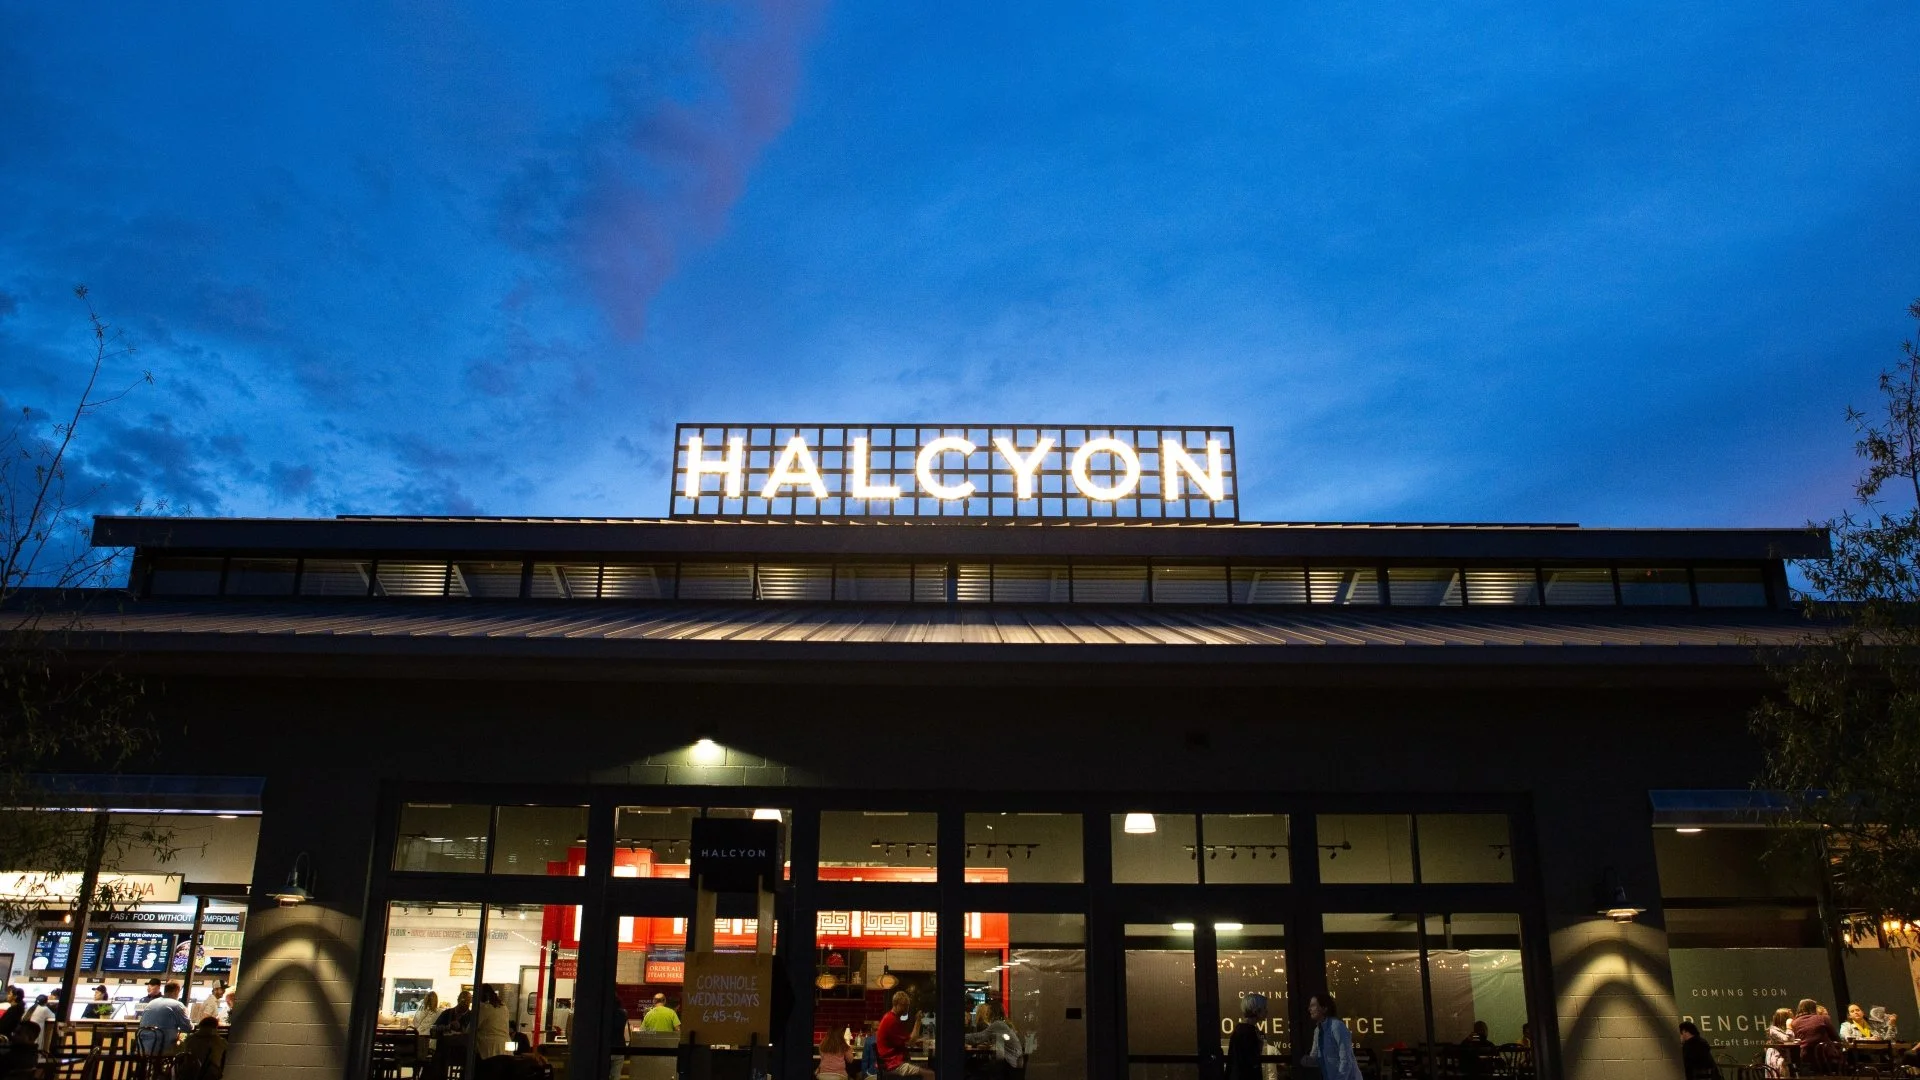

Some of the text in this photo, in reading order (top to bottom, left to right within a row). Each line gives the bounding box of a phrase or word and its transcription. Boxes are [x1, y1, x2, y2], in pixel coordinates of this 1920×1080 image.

[684, 436, 1224, 502] HALCYON
[701, 849, 766, 858] HALCYON
[132, 913, 155, 921] FOOD
[157, 913, 193, 922] WITHOUT
[202, 914, 239, 923] OMPROMIS
[697, 975, 759, 991] CORNHOLE
[1692, 988, 1788, 997] COMING SOON
[687, 992, 760, 1007] WEDNESDAYS
[1713, 1038, 1739, 1046] Craft
